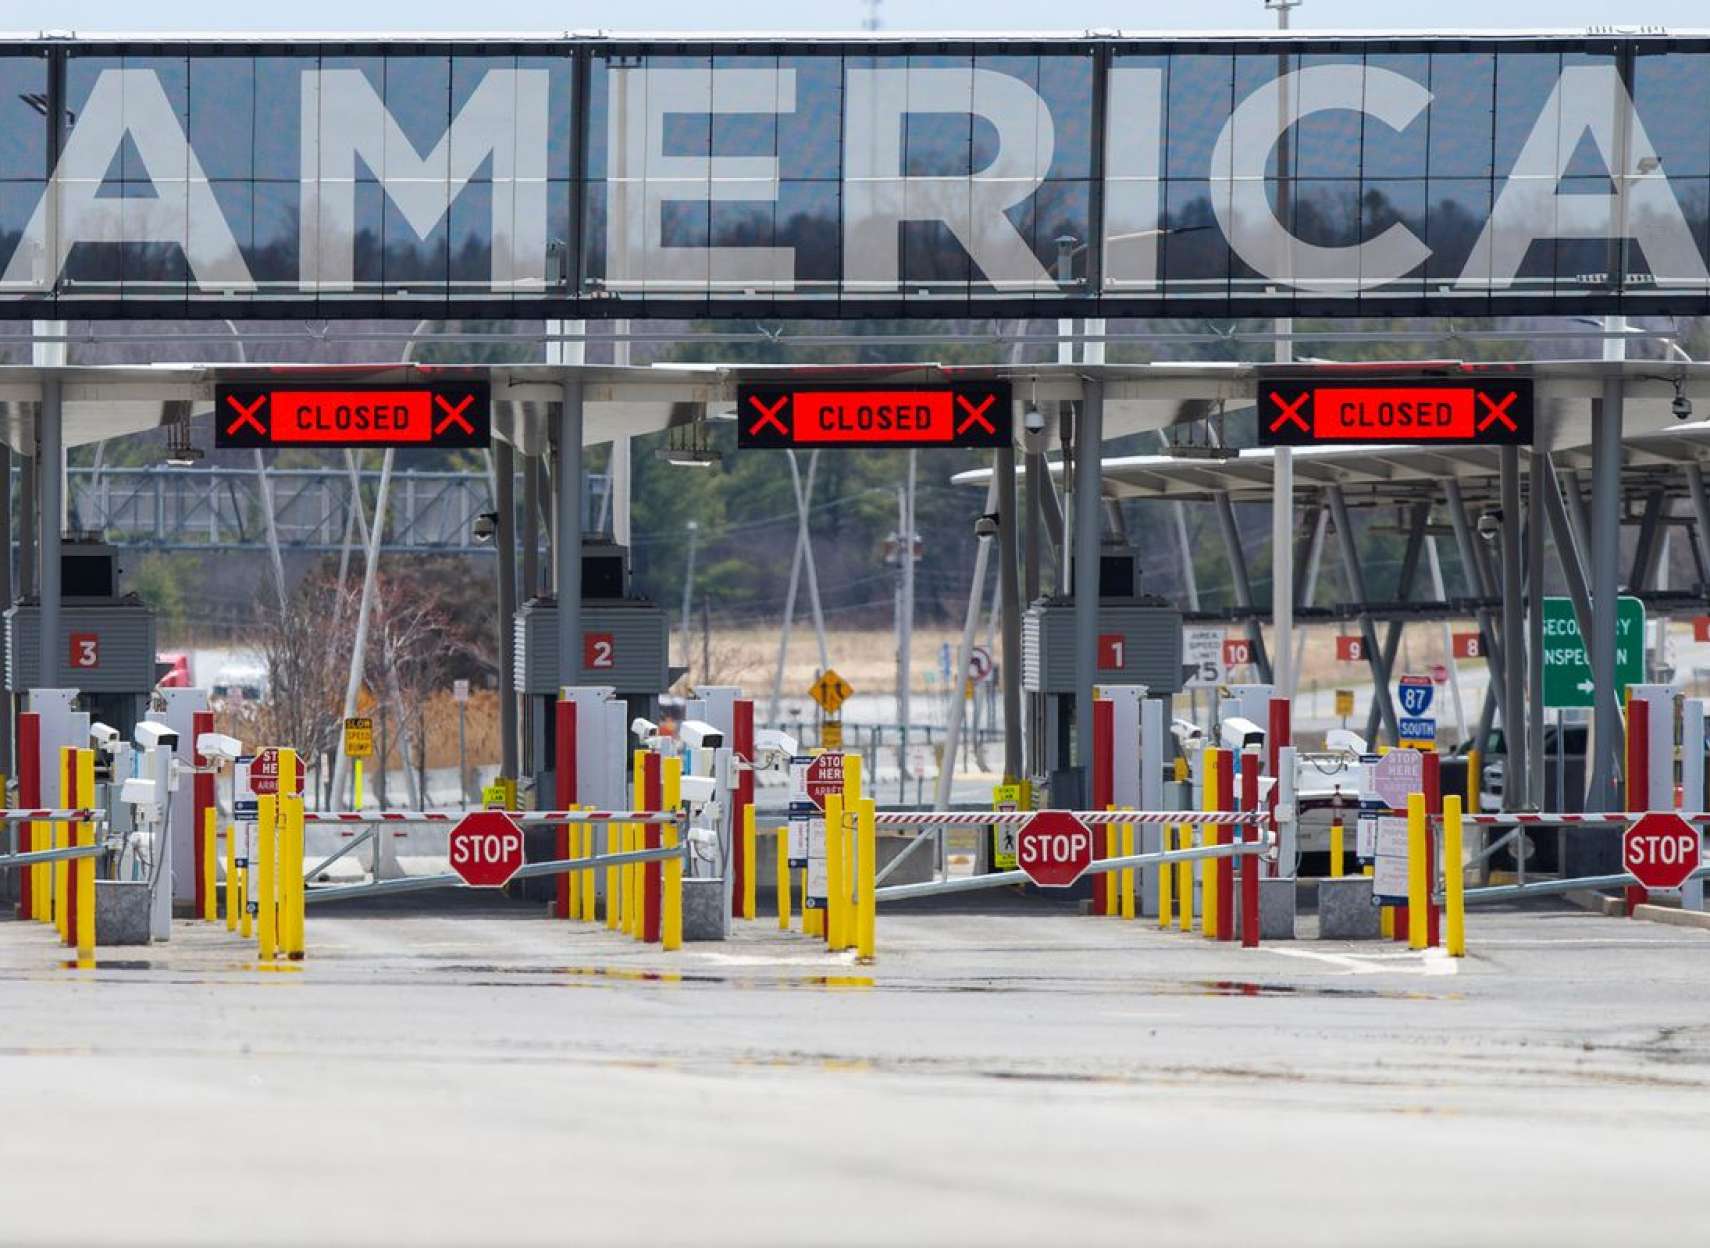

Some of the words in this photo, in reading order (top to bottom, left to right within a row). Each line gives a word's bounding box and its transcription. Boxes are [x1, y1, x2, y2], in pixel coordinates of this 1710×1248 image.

[0, 62, 1710, 296] AMERICA
[295, 405, 410, 430] CLOSED
[818, 405, 932, 431] CLOSED
[1339, 402, 1453, 428] CLOSED
[79, 641, 97, 666] 3
[592, 641, 612, 666] 2
[1110, 641, 1123, 667] 1
[1227, 644, 1249, 663] 10
[1349, 641, 1361, 659] 9
[1467, 638, 1479, 656] 8
[1405, 688, 1426, 710] 87
[1401, 722, 1434, 736] SOUTH
[819, 756, 844, 768] STO
[1390, 752, 1417, 764] STOP
[818, 768, 844, 780] HER
[453, 834, 519, 863] STOP
[1021, 833, 1088, 863] STOP
[1629, 835, 1695, 865] STOP
